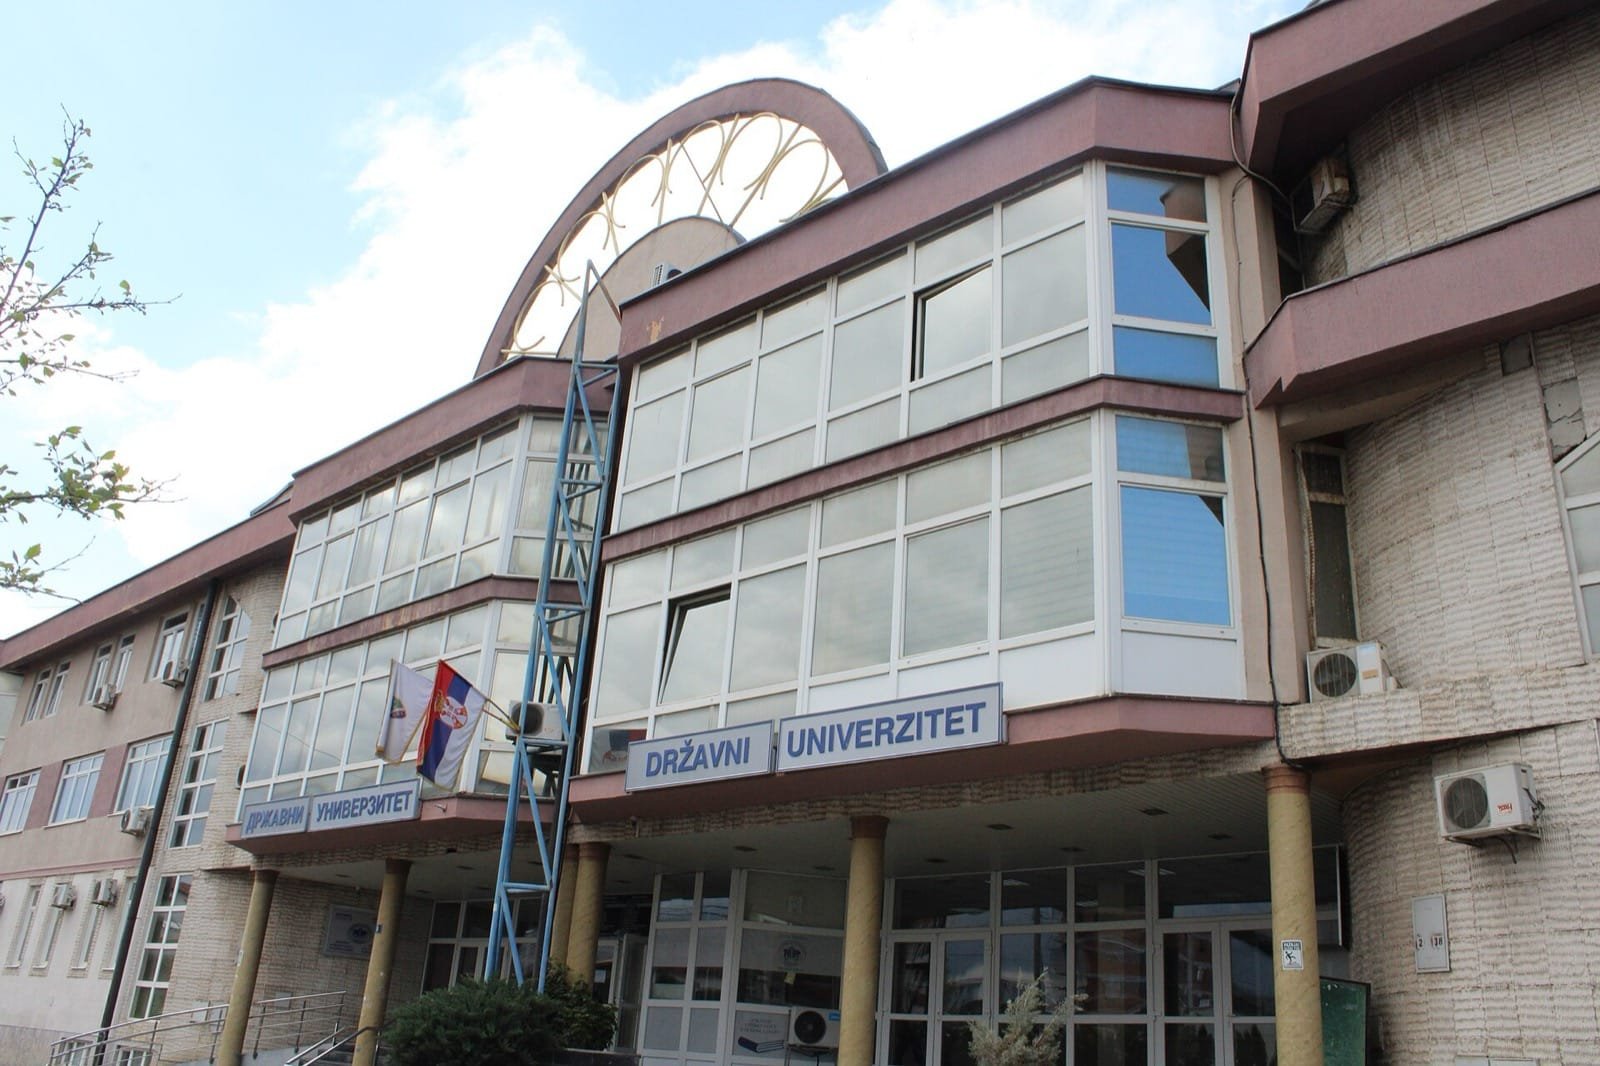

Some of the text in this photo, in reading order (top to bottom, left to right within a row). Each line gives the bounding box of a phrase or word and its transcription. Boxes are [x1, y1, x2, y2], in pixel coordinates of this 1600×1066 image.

[645, 702, 986, 777] DRŽAVNI UNIVERZITET
[246, 790, 413, 833] ДРЖАВНИ УНИВЕРЗИТЕТ
